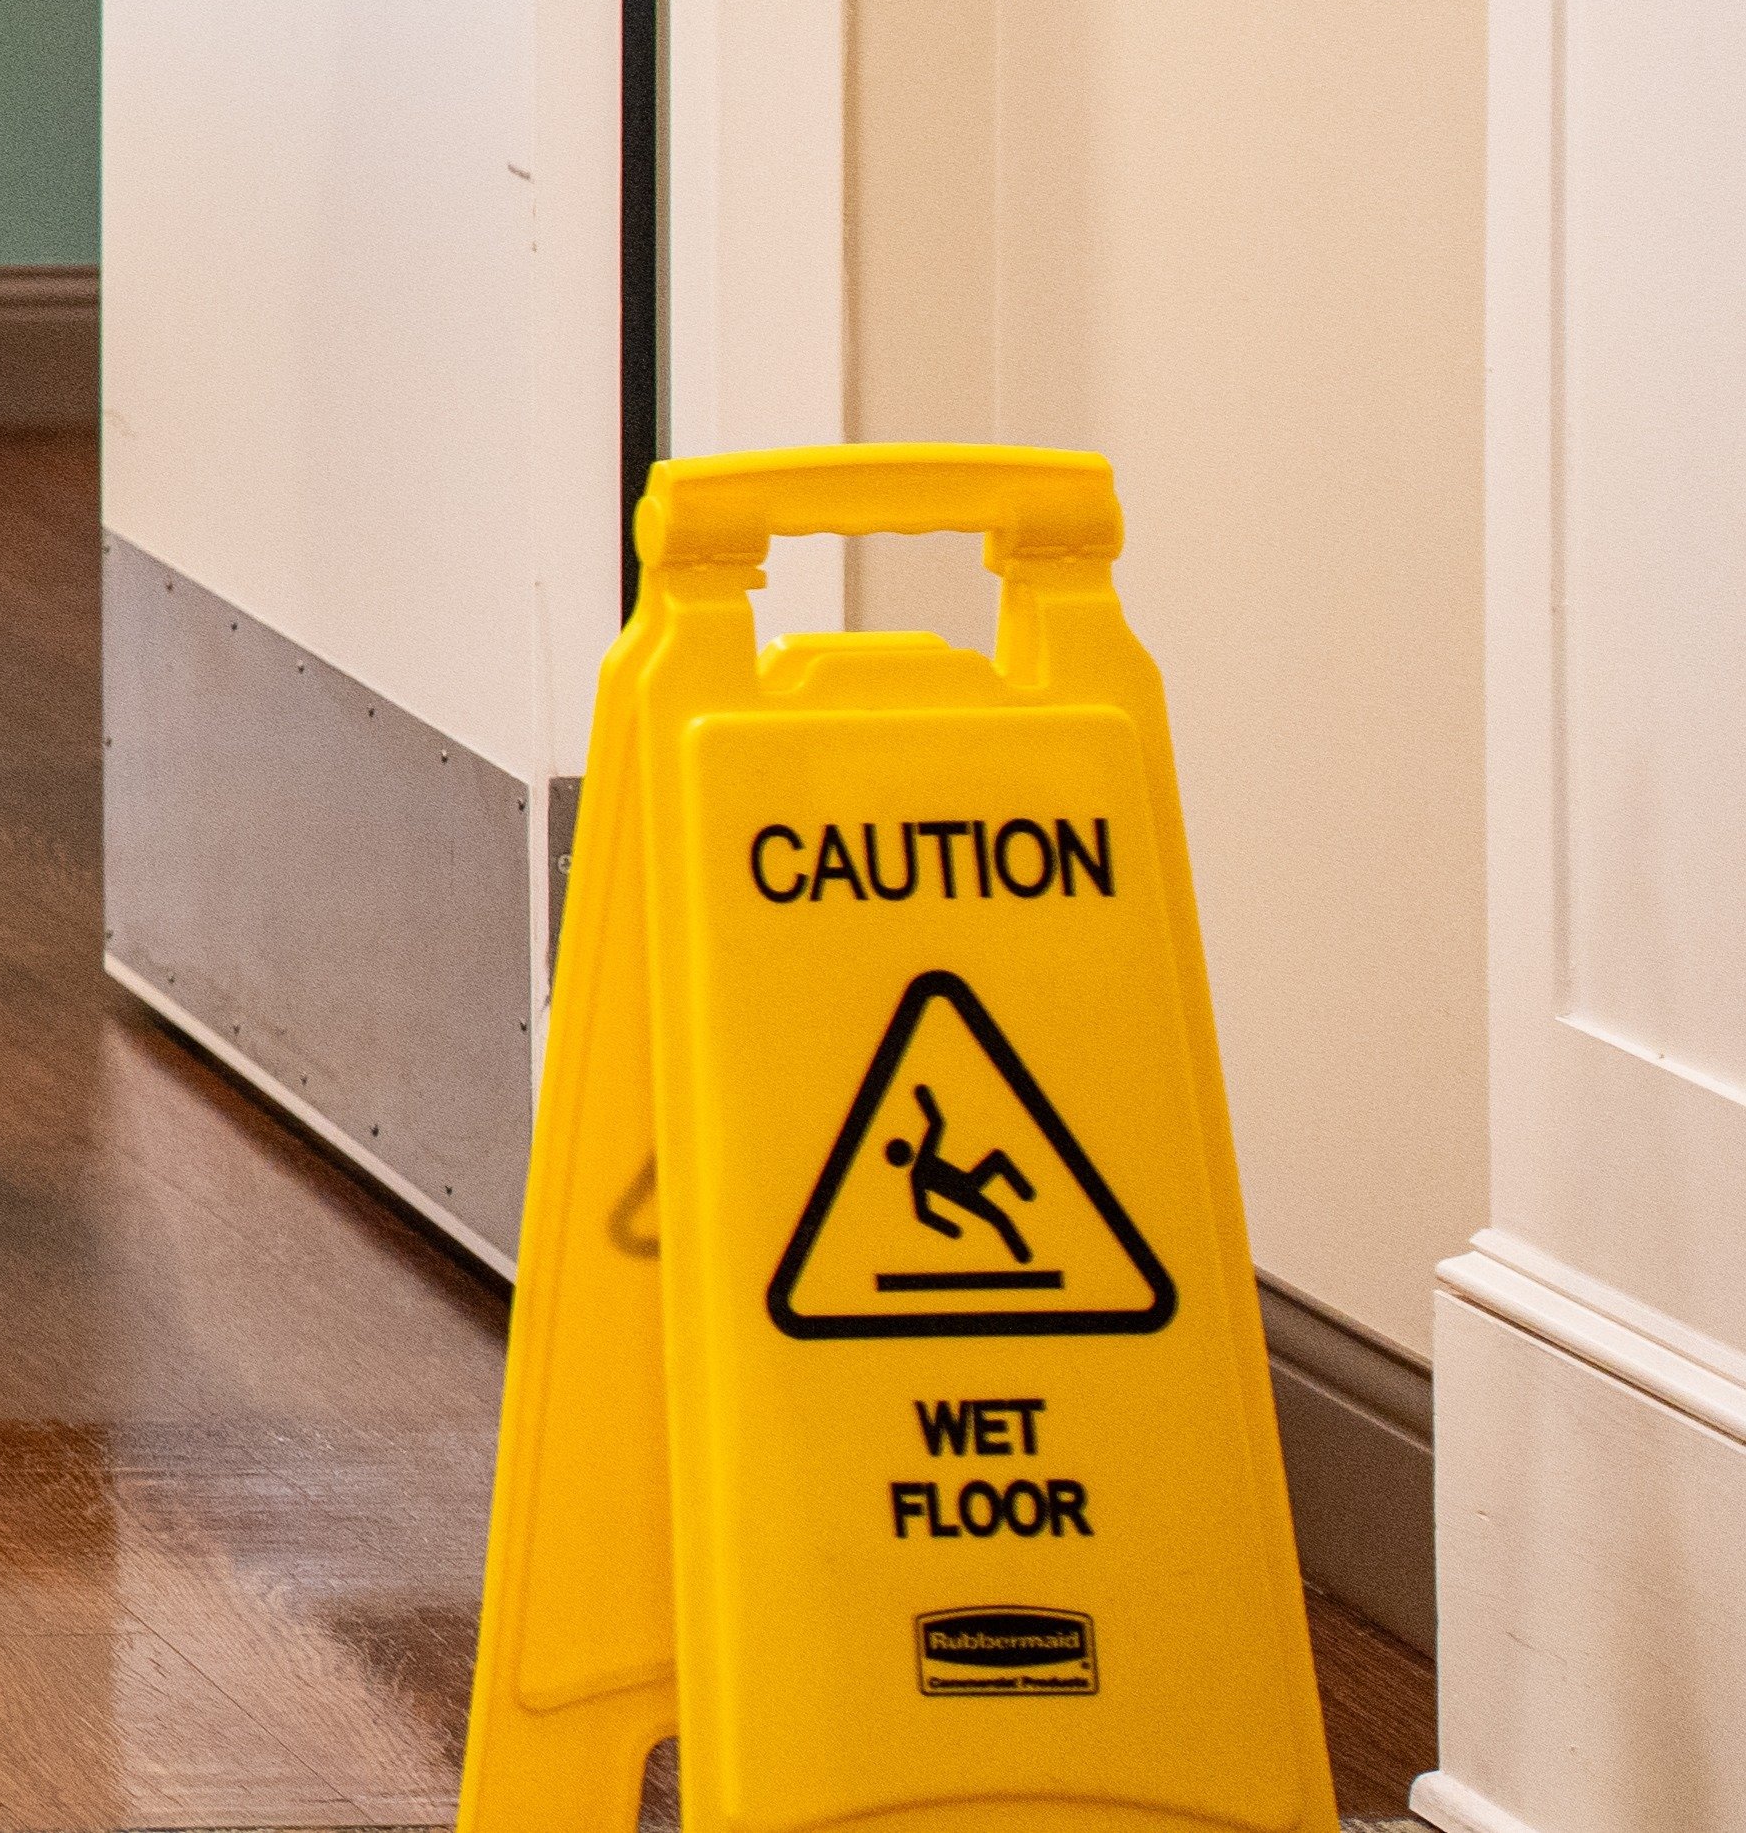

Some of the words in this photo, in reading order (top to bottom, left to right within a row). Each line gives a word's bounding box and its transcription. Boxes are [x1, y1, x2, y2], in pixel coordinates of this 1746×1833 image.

[749, 818, 1116, 904] CAUTION
[914, 1398, 1047, 1457] WET
[890, 1479, 1095, 1539] FLOOR
[929, 1631, 1082, 1650] Rubbermaid
